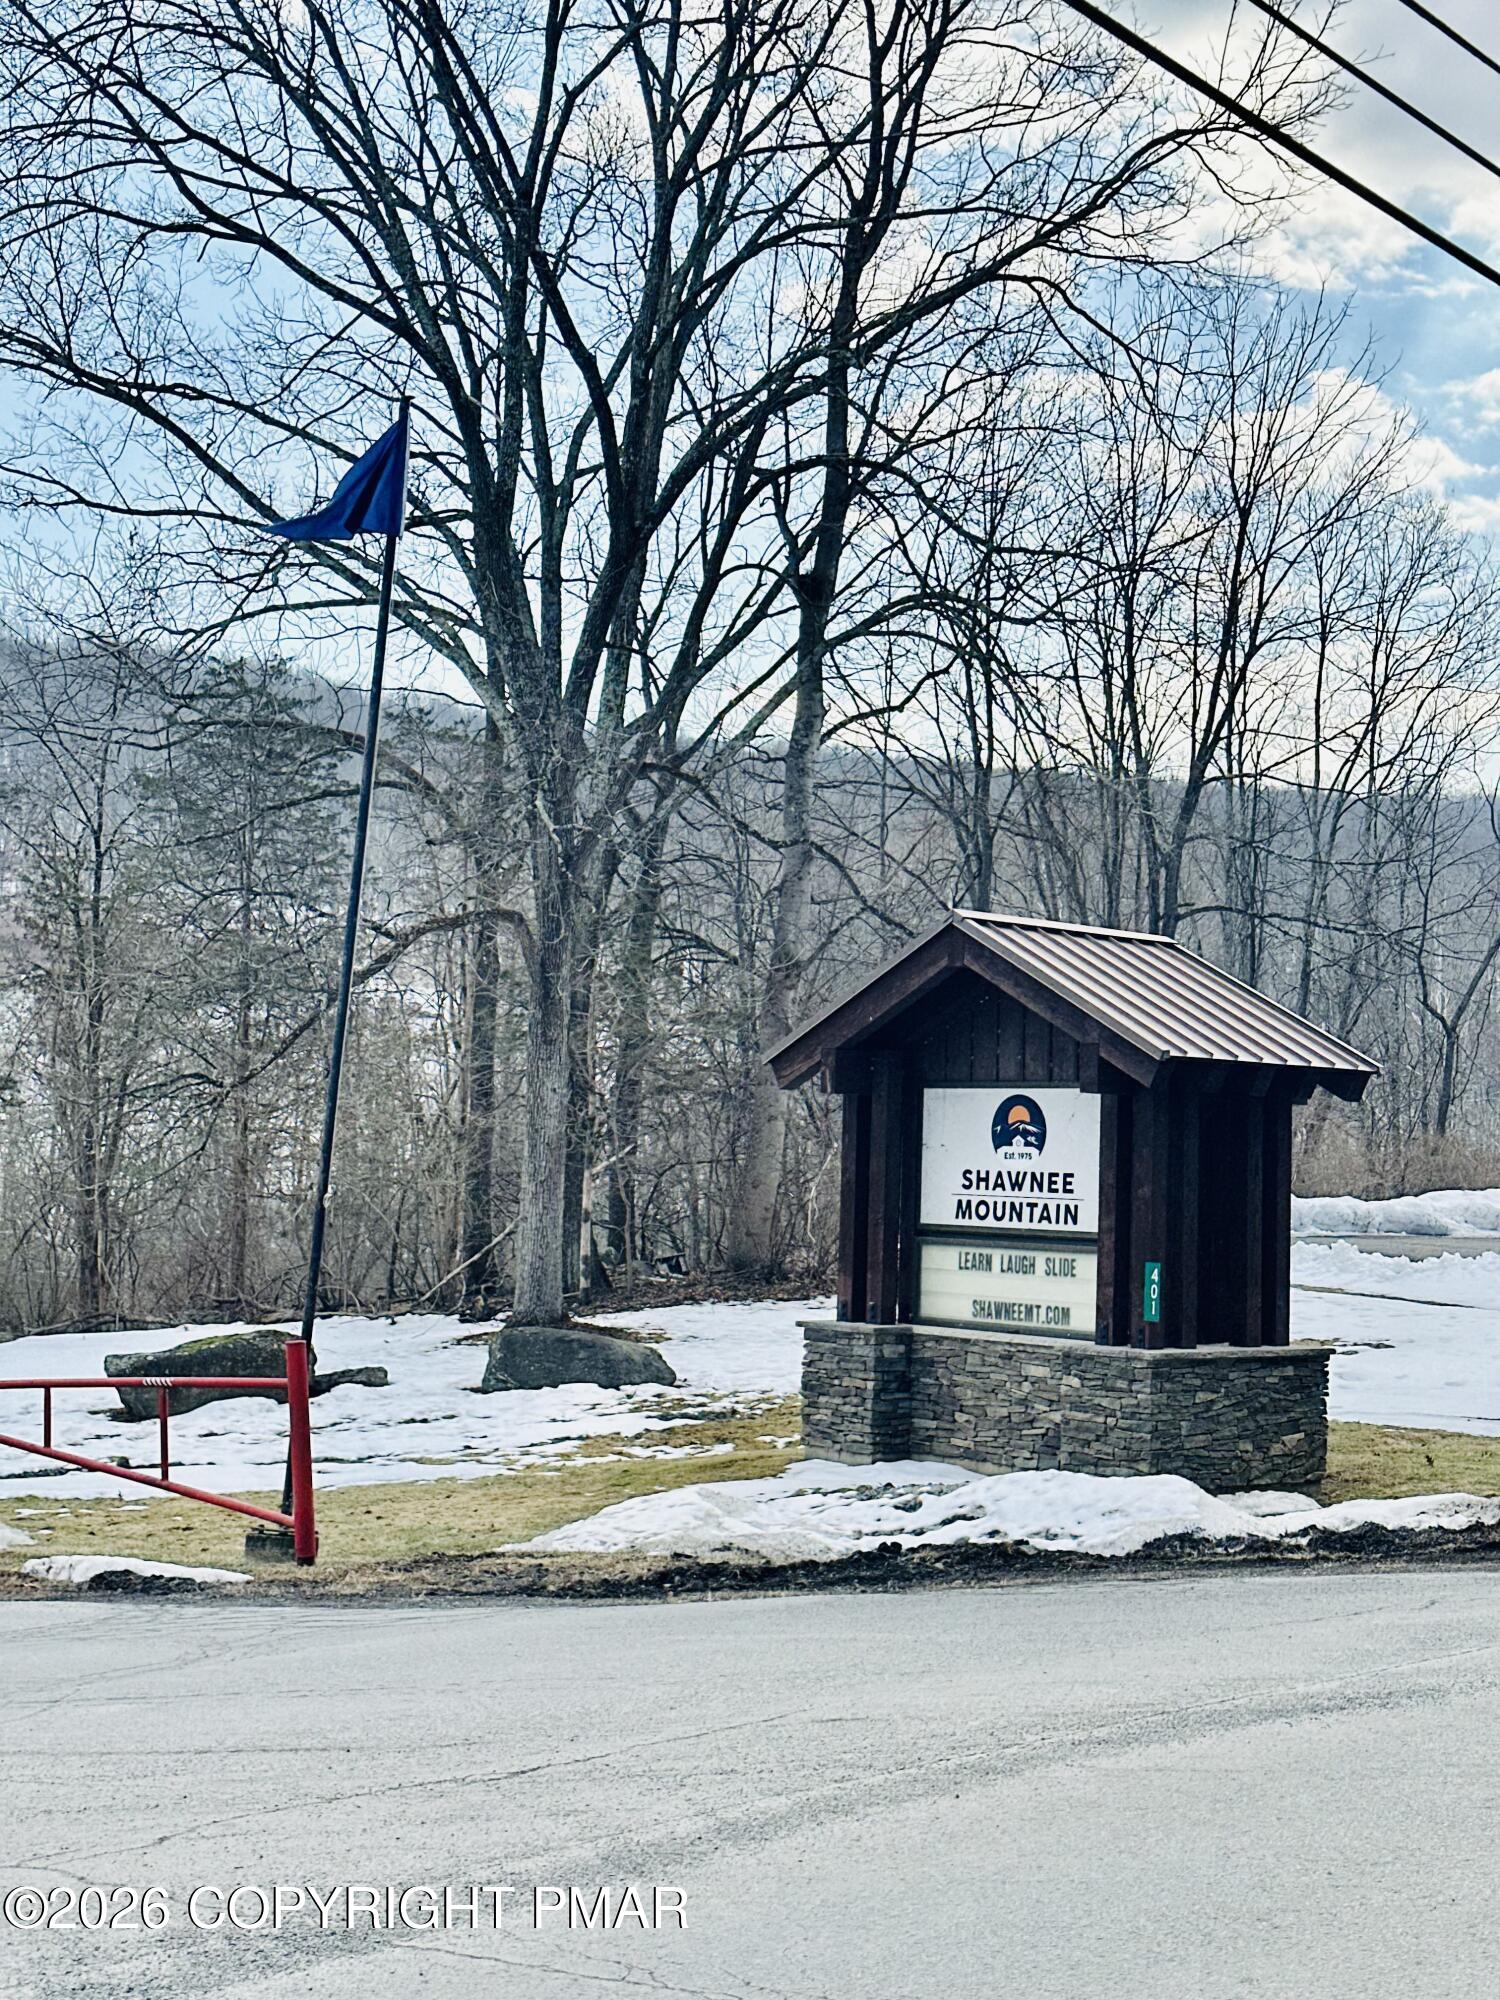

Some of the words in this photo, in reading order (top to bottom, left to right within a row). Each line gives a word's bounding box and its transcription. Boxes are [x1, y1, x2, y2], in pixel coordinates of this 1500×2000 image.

[1017, 1152, 1033, 1161] 1975
[961, 1169, 1075, 1194] SHAWNEE
[955, 1199, 1079, 1226] MOUNTAIN
[958, 1250, 993, 1272] LEARN
[1000, 1254, 1036, 1276] LAUGH
[1044, 1256, 1077, 1278] SLIDE
[1150, 1268, 1159, 1315] 401
[971, 1298, 1071, 1326] SHAWNEEMT.COM
